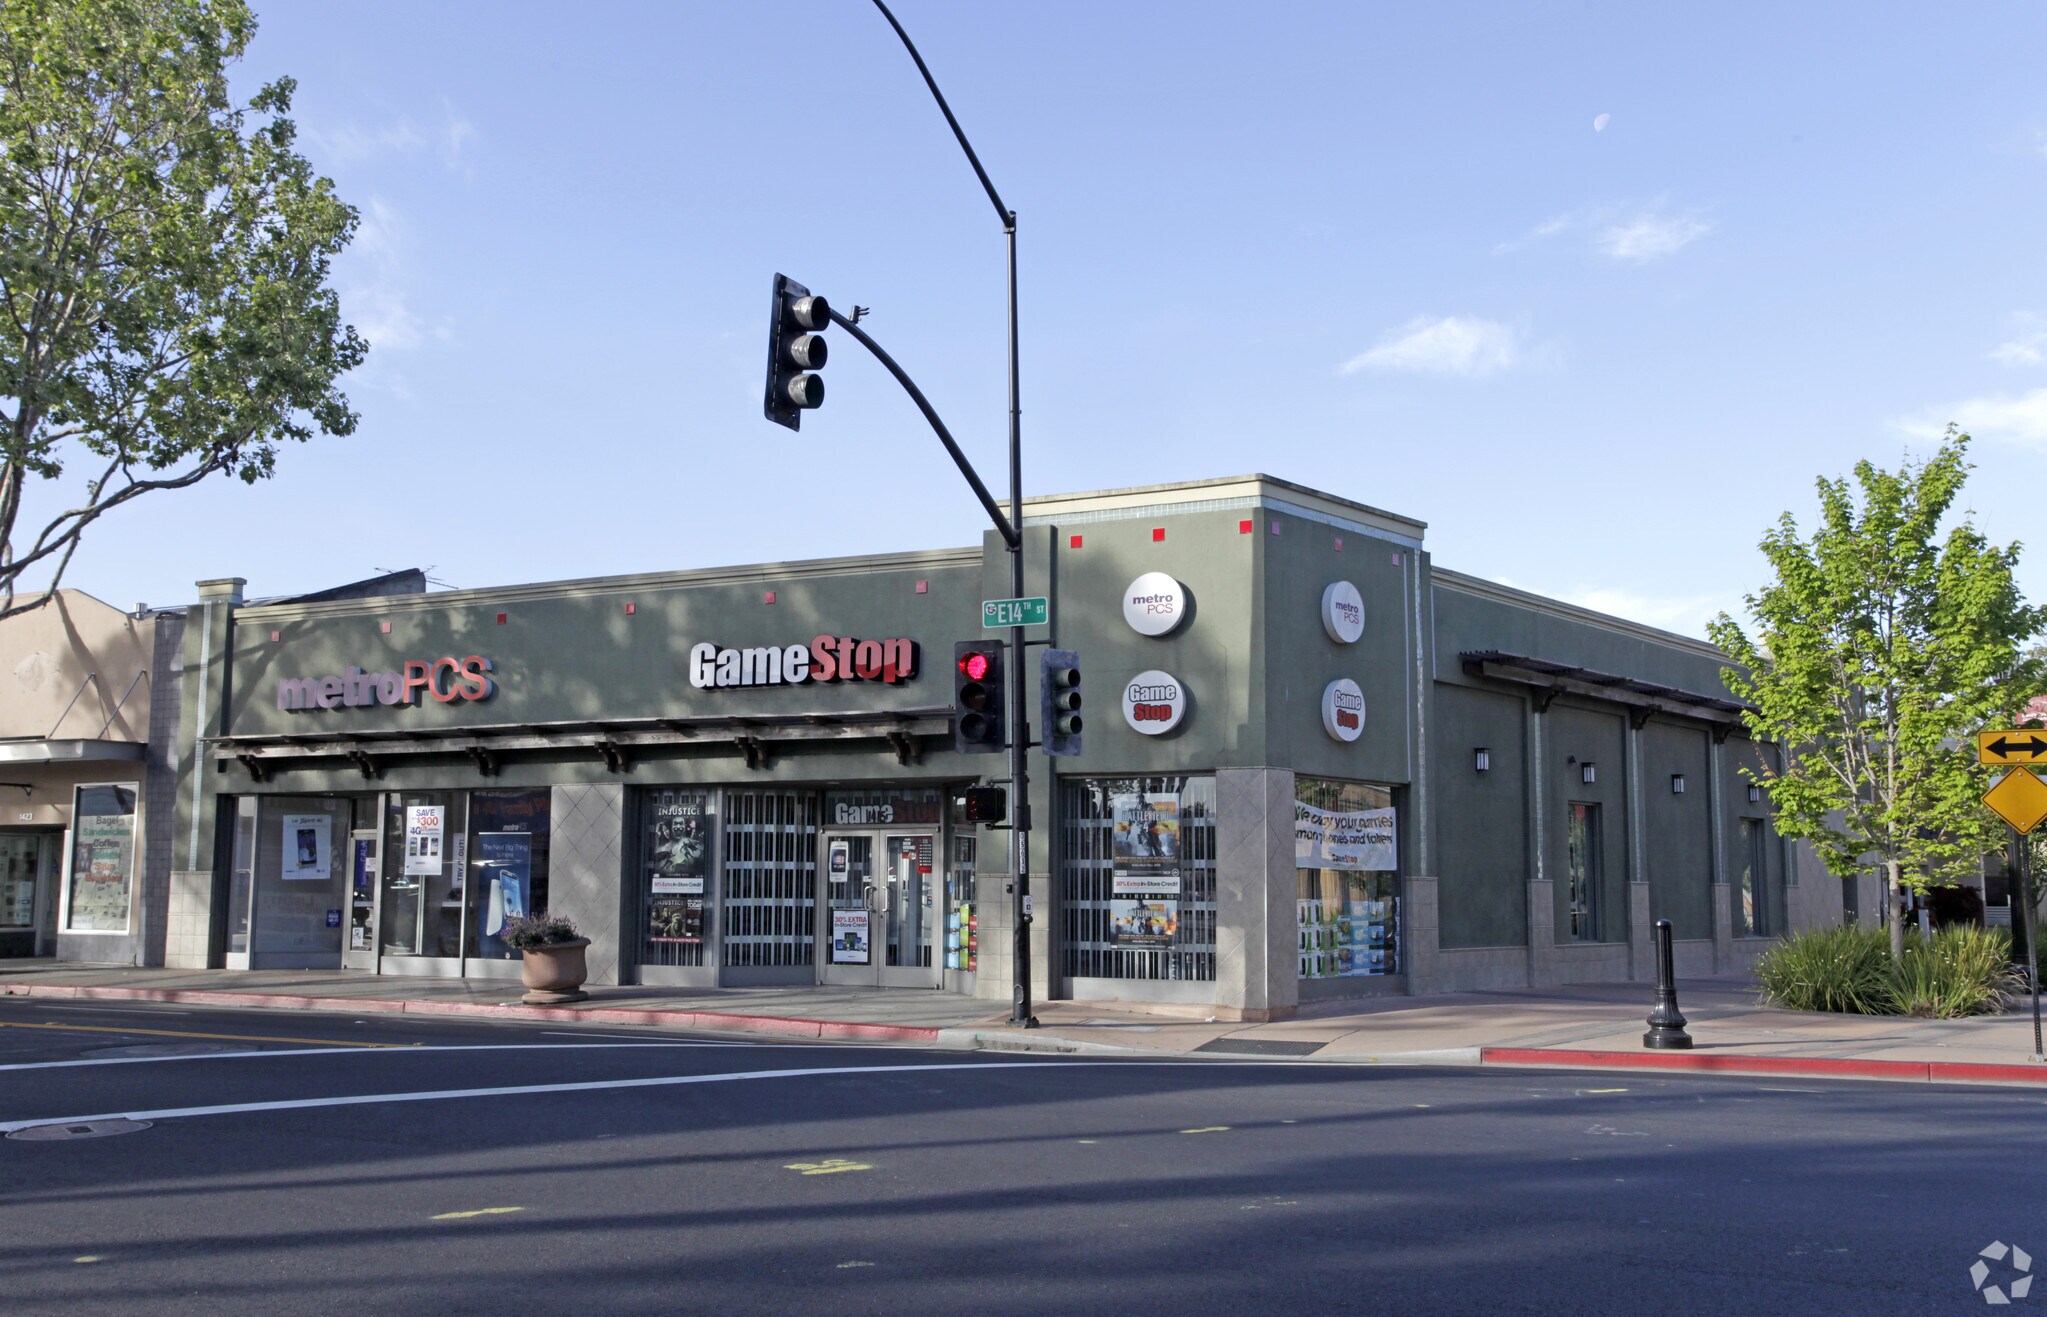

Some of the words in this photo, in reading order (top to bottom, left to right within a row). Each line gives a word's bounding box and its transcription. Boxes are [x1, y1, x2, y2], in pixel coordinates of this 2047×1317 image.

[1133, 594, 1173, 604] metro
[1036, 605, 1044, 614] ST
[1147, 604, 1173, 614] PCS
[1335, 601, 1358, 613] metro
[1344, 612, 1359, 624] PCS
[690, 634, 912, 688] GameStop
[277, 655, 492, 710] metroPCS
[1129, 684, 1176, 702] Game
[1334, 690, 1361, 711] Game
[1134, 703, 1172, 721] Stop
[1336, 709, 1359, 730] Stop
[658, 807, 701, 816] INJUSTICE
[417, 817, 438, 826] $300
[1335, 817, 1357, 829] your
[1358, 816, 1393, 832] games
[1350, 833, 1365, 844] and
